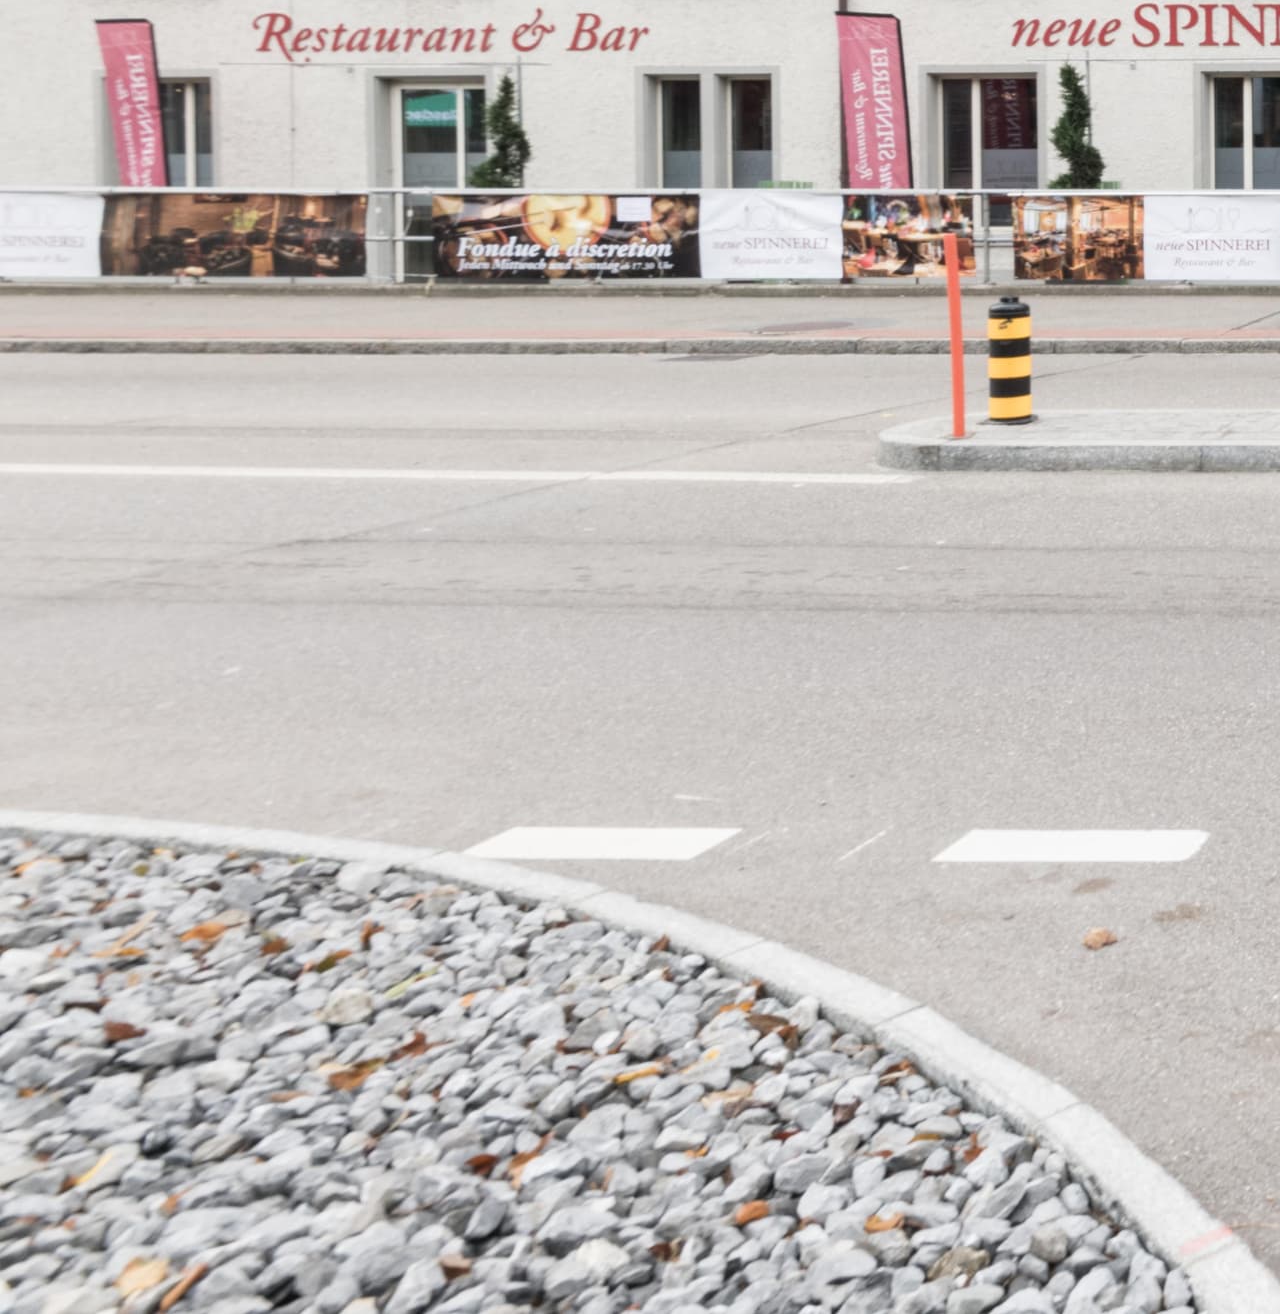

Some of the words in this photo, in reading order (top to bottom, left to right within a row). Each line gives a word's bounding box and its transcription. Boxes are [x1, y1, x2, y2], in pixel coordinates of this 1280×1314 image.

[252, 12, 497, 62] Restaurant
[512, 8, 556, 52] &
[567, 13, 650, 52] Bar
[1011, 17, 1122, 47] neue
[456, 237, 541, 258] Fondue
[545, 240, 560, 258] à
[566, 237, 673, 258] discretion
[744, 237, 829, 250] SPINNEREI
[1156, 241, 1185, 251] neue
[1186, 238, 1270, 251] SPINNEREI
[457, 258, 490, 271] Jeden
[492, 258, 546, 273] Mittwoch
[574, 258, 620, 273] Sonntag
[1173, 257, 1223, 268] Restaurant
